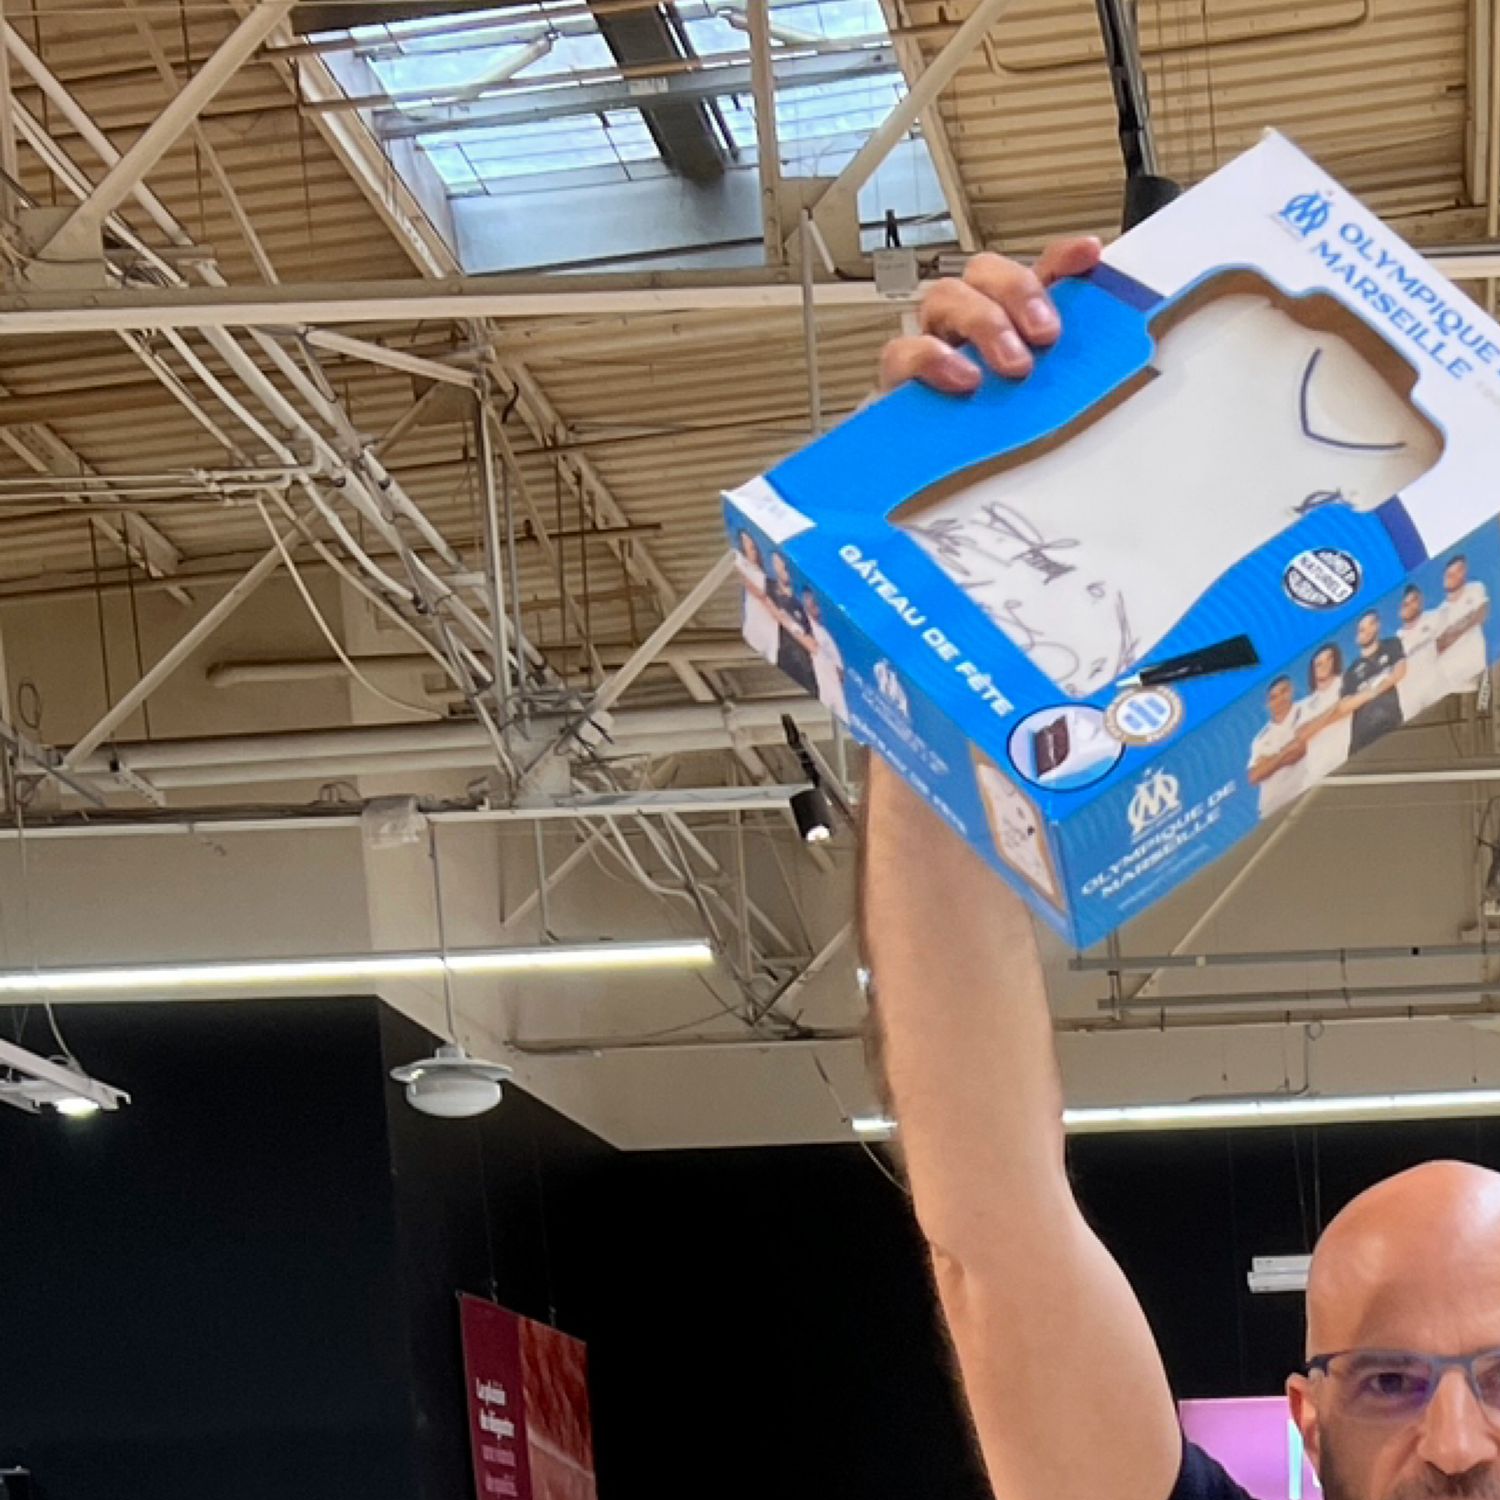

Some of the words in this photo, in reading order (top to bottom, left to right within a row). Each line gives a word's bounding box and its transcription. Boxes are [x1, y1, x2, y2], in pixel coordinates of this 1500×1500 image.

[1310, 240, 1474, 380] MARSEILLE
[838, 544, 926, 627] GÂTEAU
[921, 626, 961, 662] DE
[955, 660, 1015, 718] FÊTE
[1081, 801, 1204, 895] OLYMPIQUE
[1207, 780, 1237, 808] DE
[1101, 807, 1222, 897] MARSEILLE
